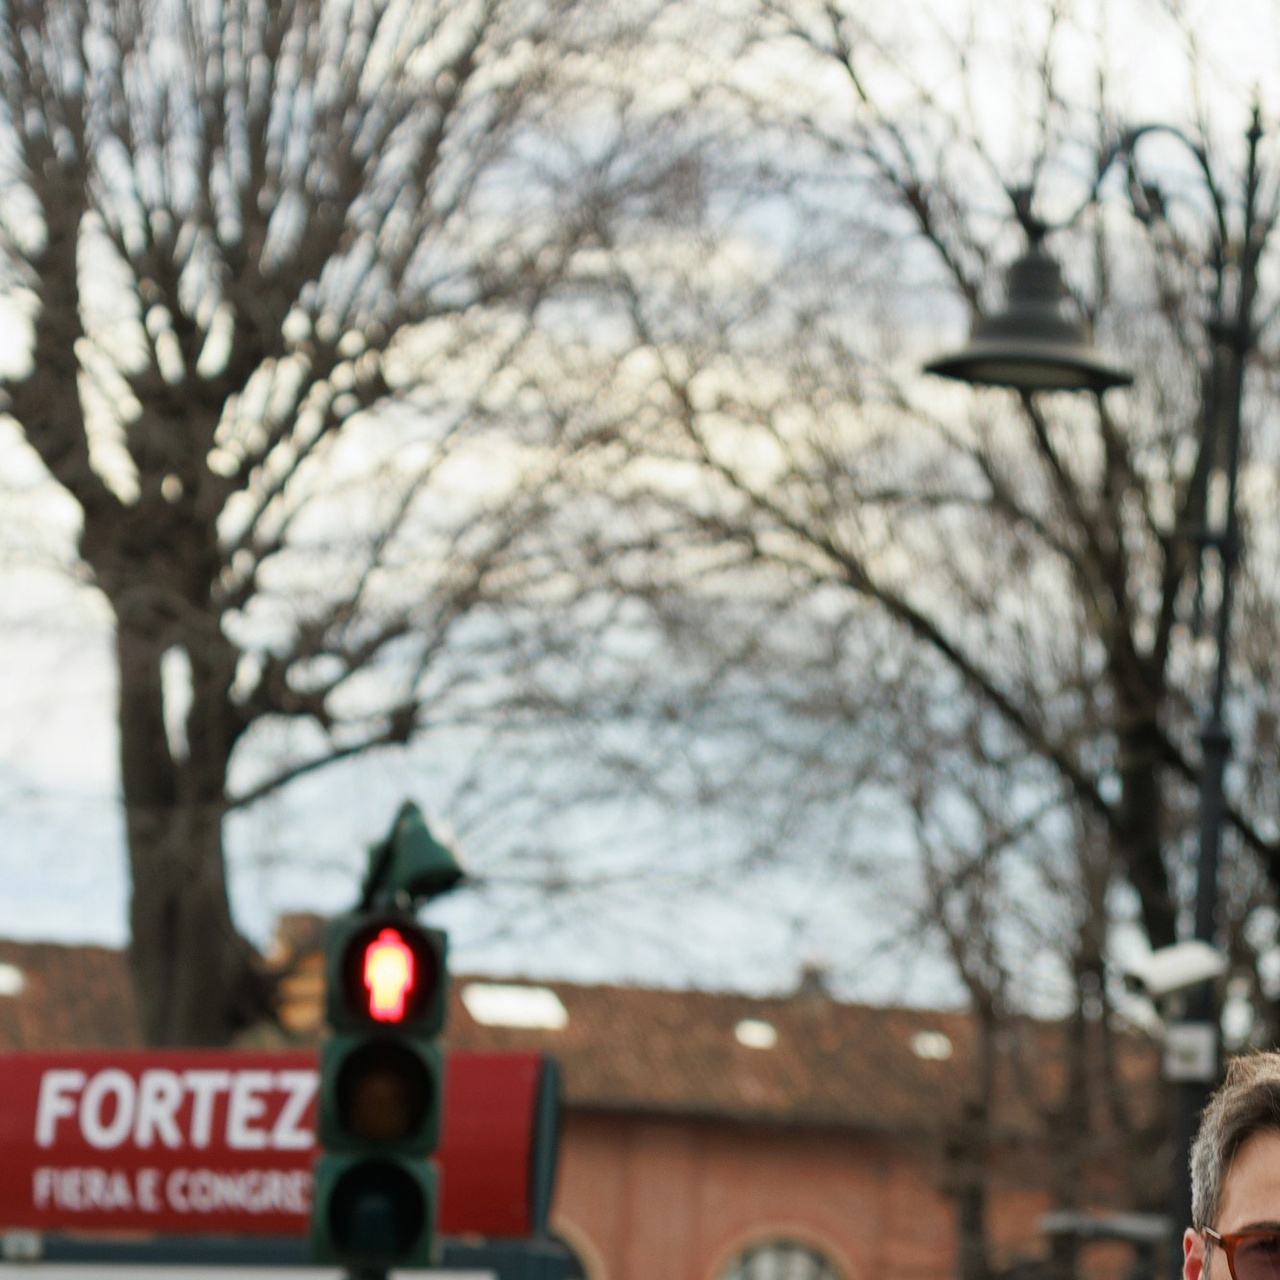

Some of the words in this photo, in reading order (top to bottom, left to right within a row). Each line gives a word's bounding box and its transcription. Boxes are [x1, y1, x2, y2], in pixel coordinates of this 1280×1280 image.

[34, 1068, 318, 1149] FORTEZ
[32, 1167, 133, 1212] FIERA
[136, 1168, 161, 1212] E
